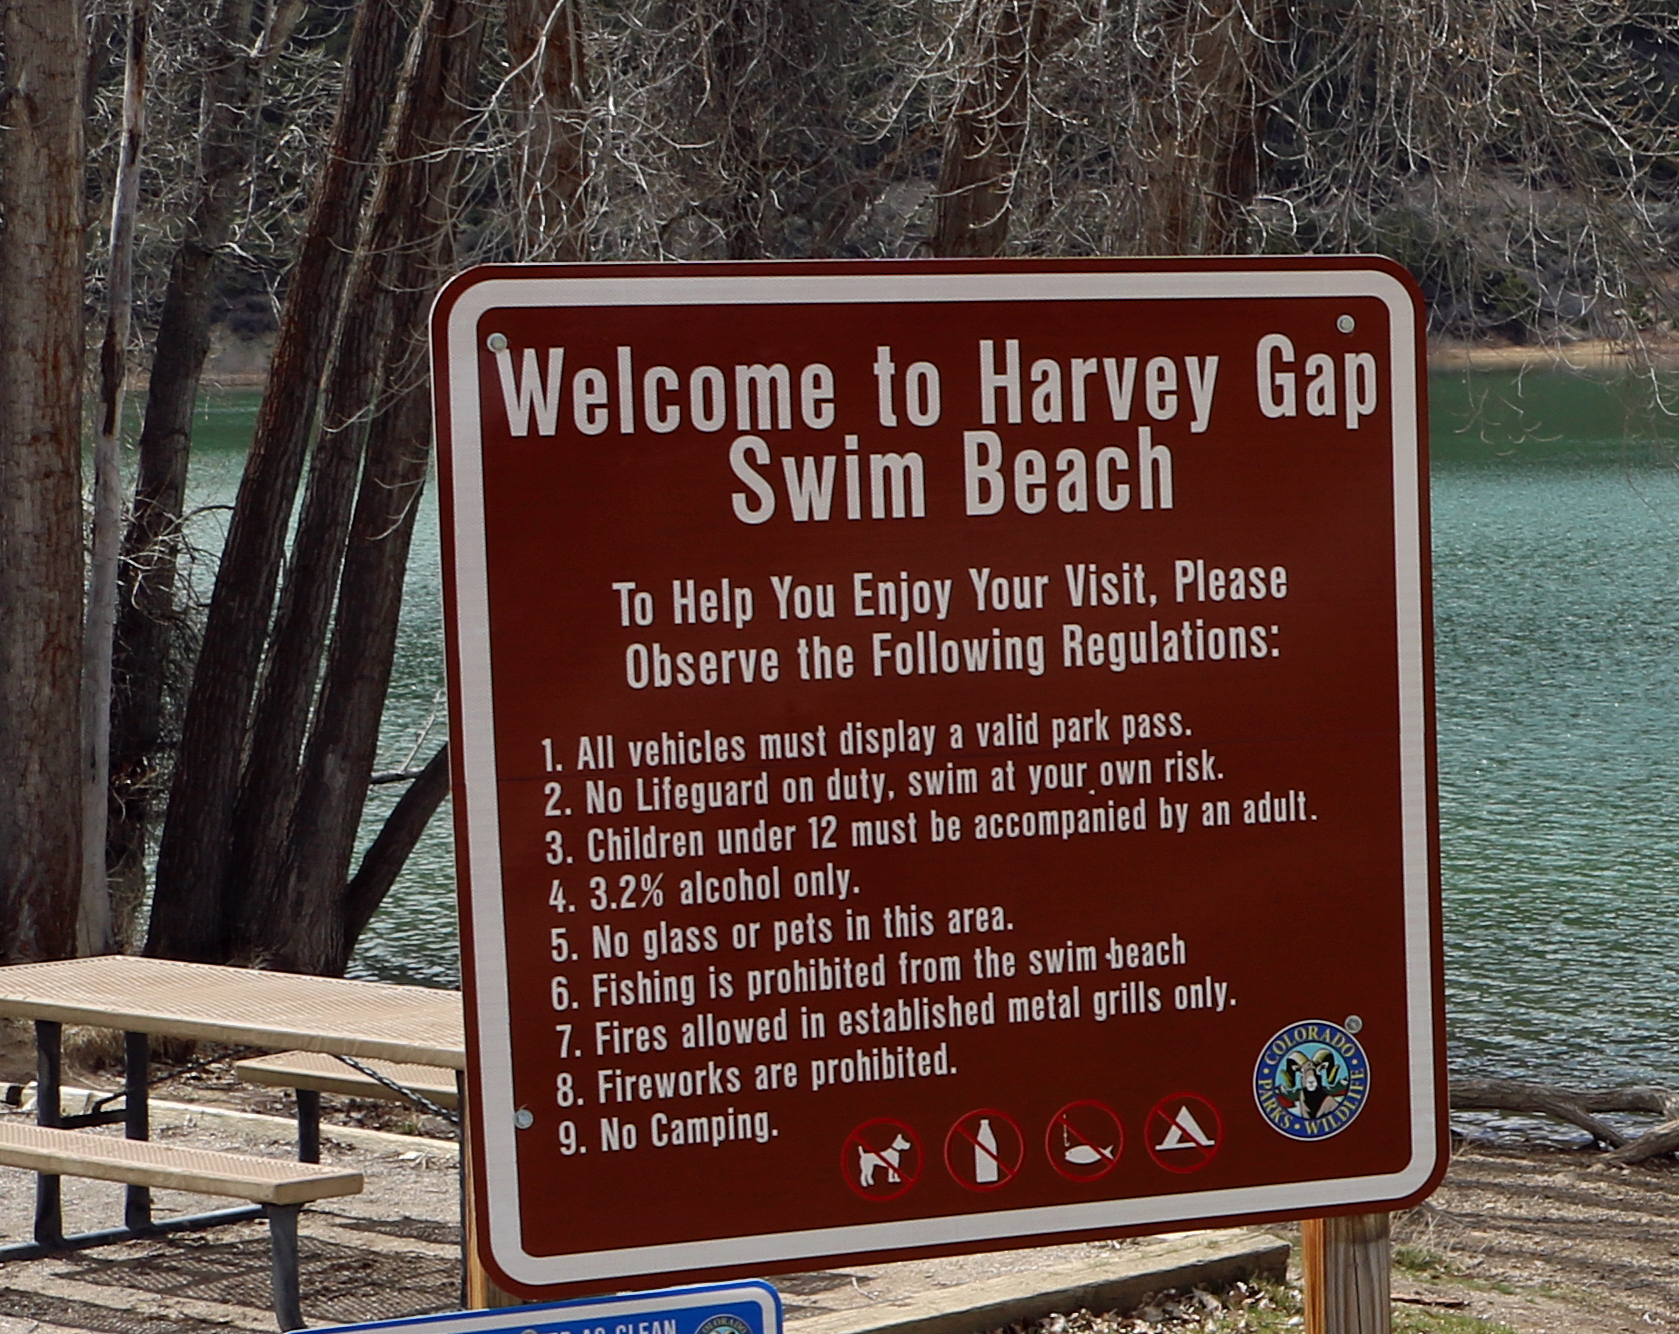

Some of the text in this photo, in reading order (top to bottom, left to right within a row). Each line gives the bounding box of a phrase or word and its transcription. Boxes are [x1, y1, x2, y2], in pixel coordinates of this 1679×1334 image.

[496, 329, 1378, 437] Welcome to Harvey Gap
[731, 425, 1174, 524] Swim Beach
[614, 556, 1287, 632] To Help You Enjoy Your Visit, Please
[627, 613, 1279, 687] Observe the Following Regulations:
[542, 706, 1191, 772] 1. All vehicles must display a valid park pass.
[545, 746, 1223, 816] 2. No Lifeguard on duty, swim at your own risk.
[546, 786, 1317, 864] 3. Children under 12 must be accompanied by an adult.
[549, 860, 859, 912] 4. 3.2% alcohol only.
[552, 902, 1013, 962] 5. No glass or pets in this area.
[552, 929, 1186, 1010] 6. Fishing is prohibited from the swim beach
[556, 973, 1236, 1058] 7. Fires allowed in established metal grills only.
[1264, 1025, 1356, 1066] COLORADO
[557, 1040, 957, 1107] 8. Fireworks are prohibited.
[1258, 1078, 1293, 1130] PARKS
[1303, 1067, 1365, 1135] WILDLIFE
[559, 1106, 778, 1154] 9. No Camping.
